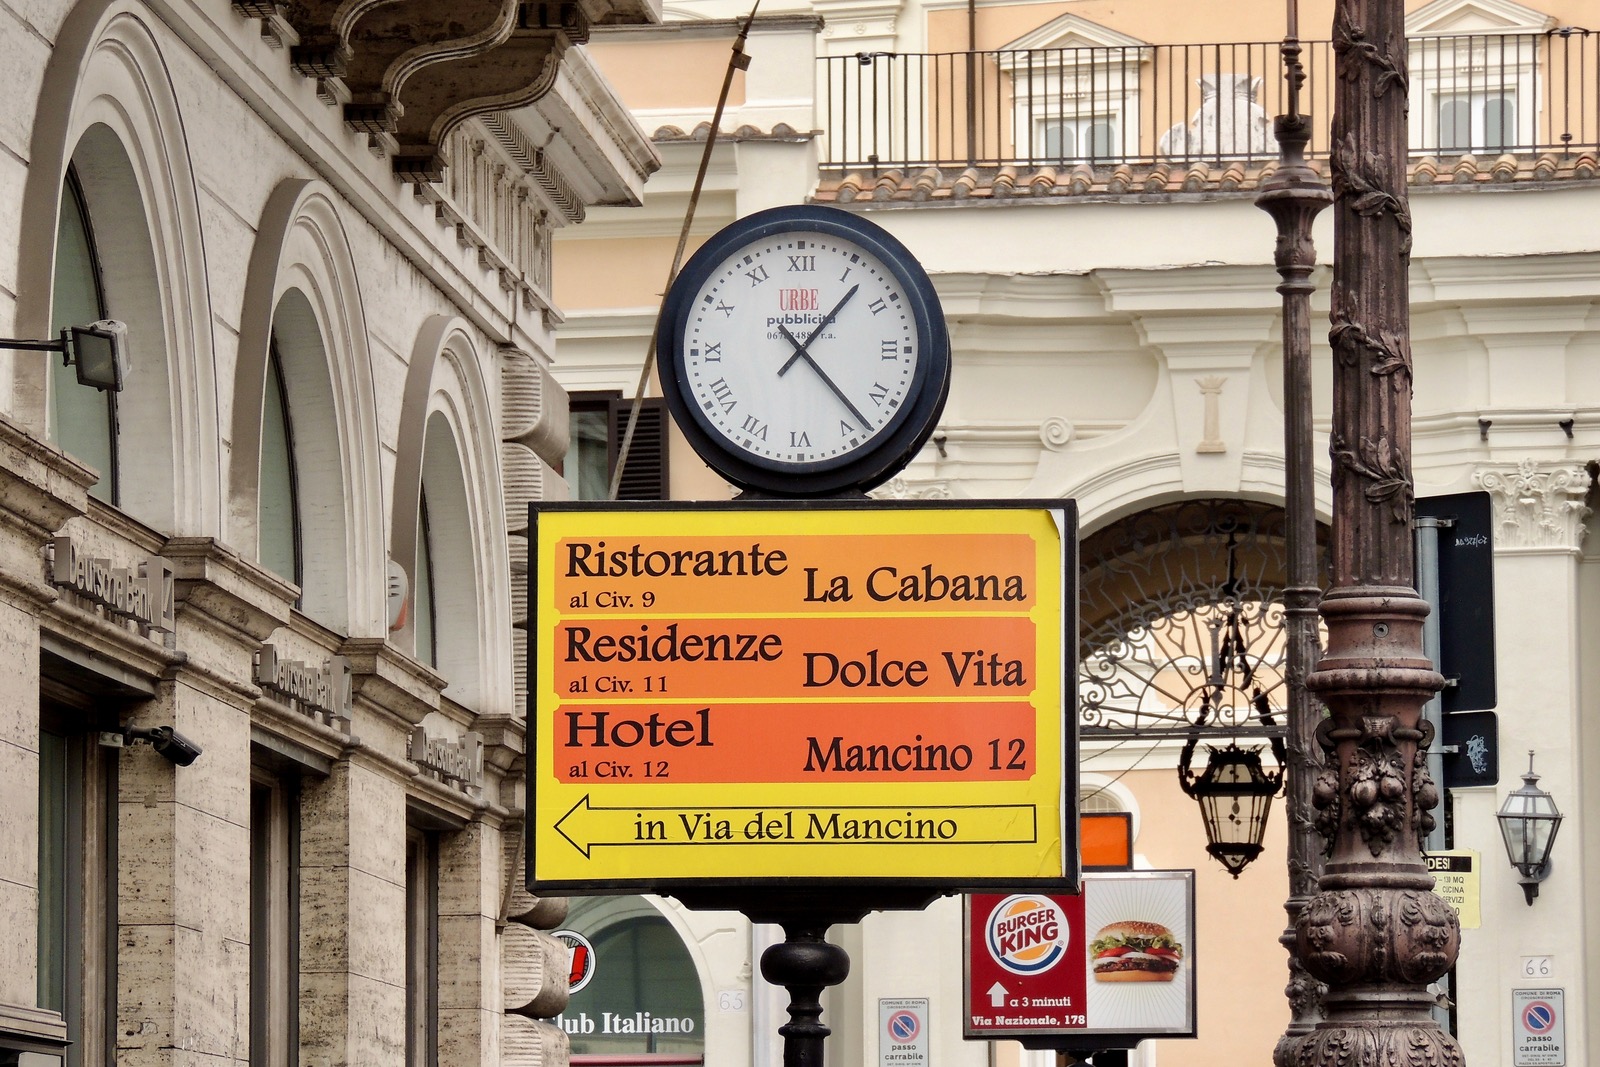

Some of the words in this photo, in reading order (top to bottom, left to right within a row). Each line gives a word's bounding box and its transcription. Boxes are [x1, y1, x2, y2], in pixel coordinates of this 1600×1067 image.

[787, 255, 816, 272] XII
[744, 264, 770, 288] XI
[715, 299, 735, 318] X
[779, 288, 819, 311] URBE
[789, 431, 812, 448] VI
[565, 541, 789, 578] Ristorante
[803, 567, 853, 603] La
[866, 564, 1027, 602] Cabana
[569, 591, 588, 608] al
[595, 591, 634, 608] Civ.
[641, 591, 656, 607] 9
[564, 623, 783, 663] Residenze
[803, 649, 929, 688] Dolce
[941, 650, 1027, 687] Vita
[569, 676, 588, 693] al
[595, 676, 634, 693] Civ.
[643, 676, 668, 693] 11
[564, 708, 714, 748] Hotel
[803, 735, 973, 772] Mancino
[989, 738, 1027, 770] 12
[569, 761, 588, 778] al
[595, 761, 634, 778] Civ.
[643, 761, 670, 778] 12
[634, 813, 668, 841] in
[679, 813, 734, 840] Via
[743, 811, 795, 841] del
[805, 812, 958, 840] Mancino
[1425, 857, 1450, 870] DESI
[1453, 876, 1464, 884] MQ
[997, 908, 1056, 938] BURGER
[1000, 921, 1059, 957] KING
[1525, 958, 1549, 975] 66
[719, 993, 743, 1010] 65
[1009, 999, 1019, 1007] a
[1021, 997, 1029, 1007] 3
[1032, 996, 1071, 1007] minuti
[540, 1012, 595, 1034] lub
[601, 1012, 695, 1034] Italiano
[972, 1016, 992, 1026] Via
[995, 1015, 1060, 1026] Nazionale,
[1064, 1015, 1086, 1025] 178
[891, 1044, 917, 1052] passo
[1527, 1035, 1552, 1043] passo
